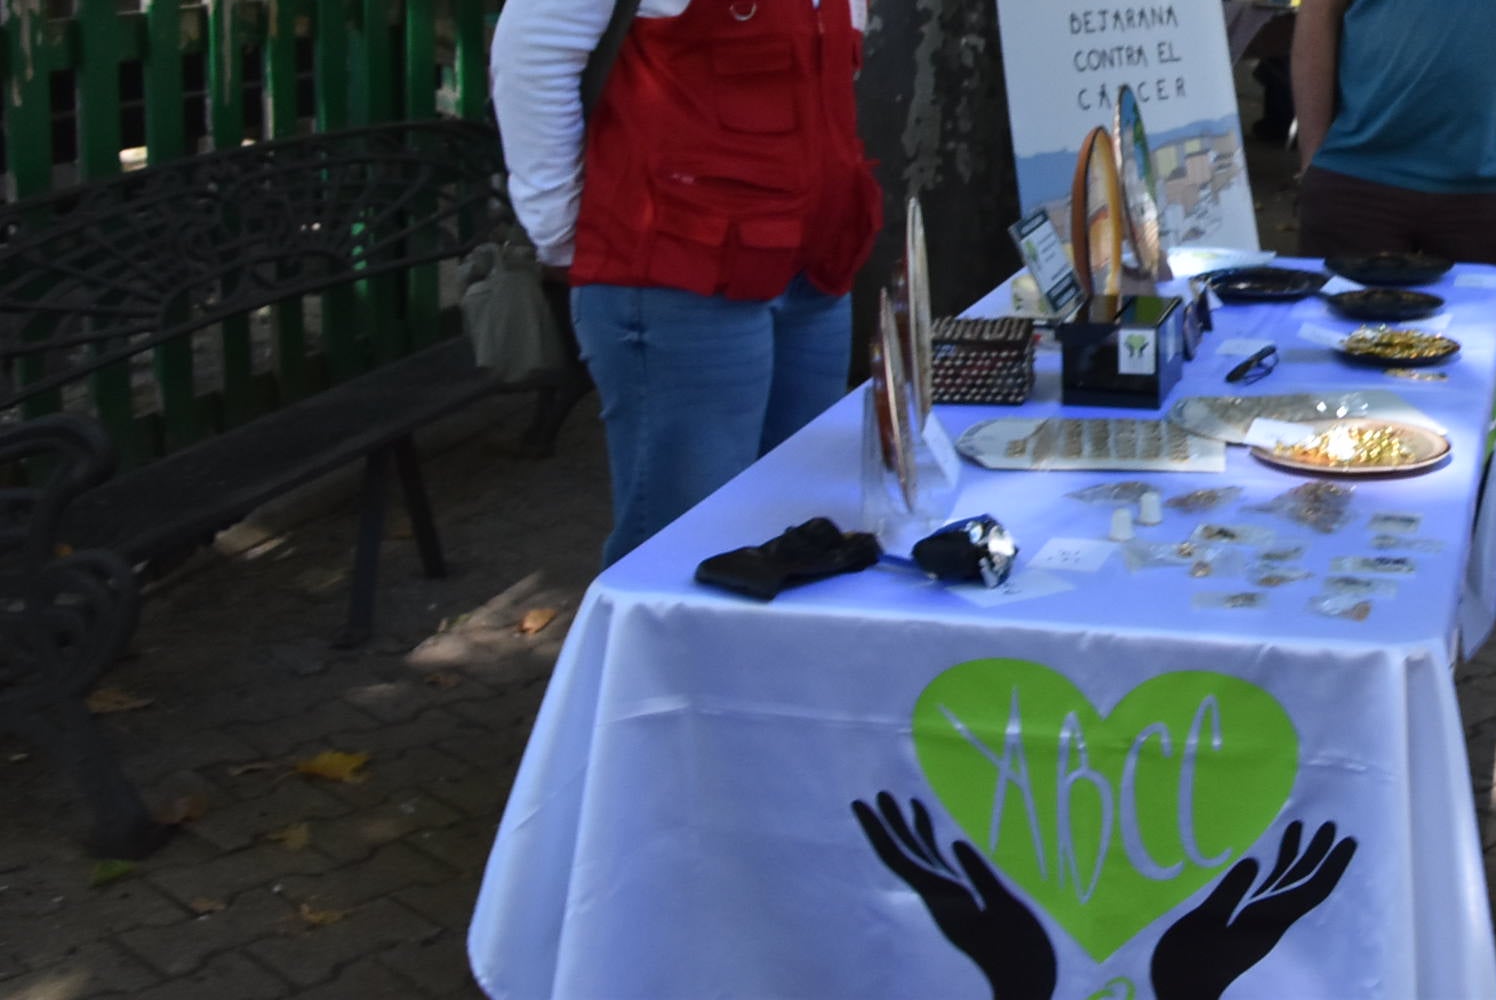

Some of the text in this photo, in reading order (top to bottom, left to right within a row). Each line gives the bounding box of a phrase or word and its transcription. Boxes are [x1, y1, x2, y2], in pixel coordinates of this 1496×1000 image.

[1069, 5, 1179, 35] BEJARANA
[1073, 41, 1182, 73] CONTRA EL
[1077, 74, 1187, 111] CÁCER
